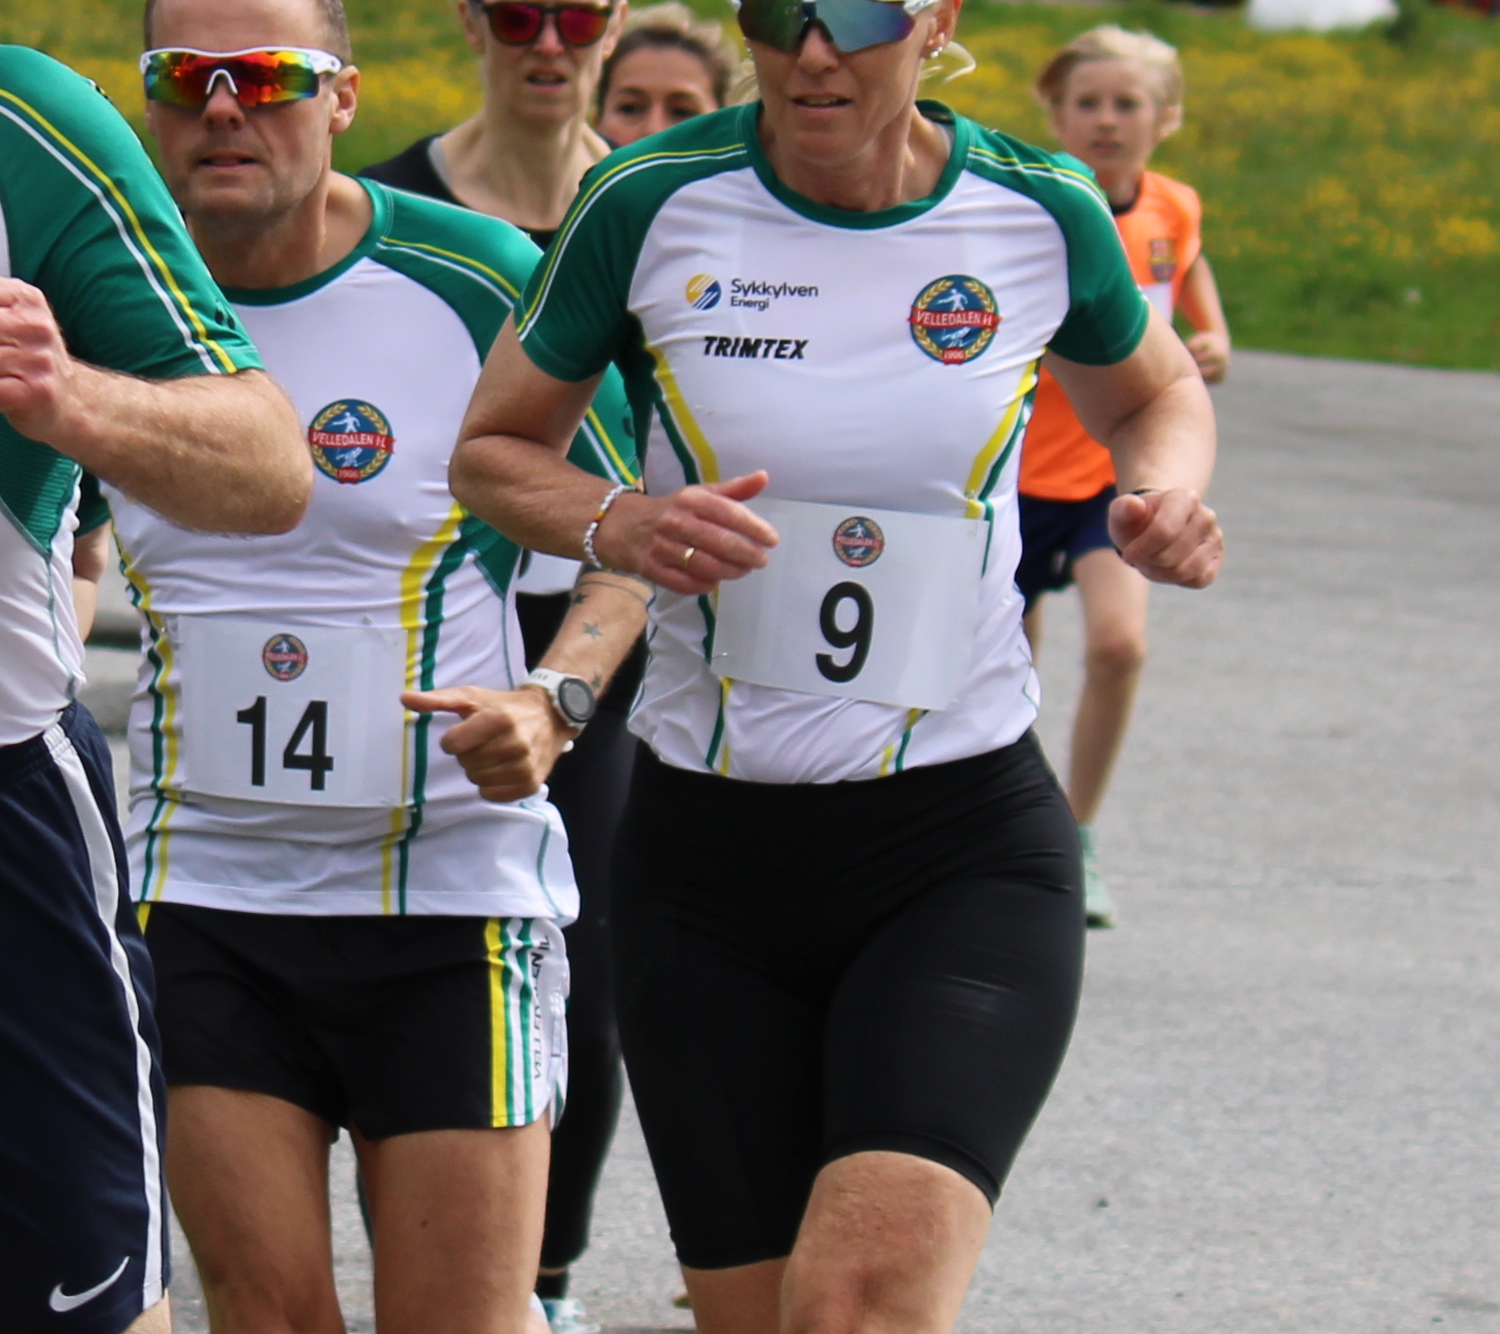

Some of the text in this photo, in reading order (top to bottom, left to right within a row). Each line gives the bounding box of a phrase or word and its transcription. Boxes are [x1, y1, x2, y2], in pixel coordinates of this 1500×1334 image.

[730, 278, 819, 299] Sykkylven
[730, 296, 770, 311] Energi
[916, 310, 981, 326] VELLEDALEN
[704, 336, 809, 359] TRIMTEX
[312, 431, 375, 446] VELLEDALEN
[815, 581, 874, 683] 9
[236, 695, 334, 791] 14
